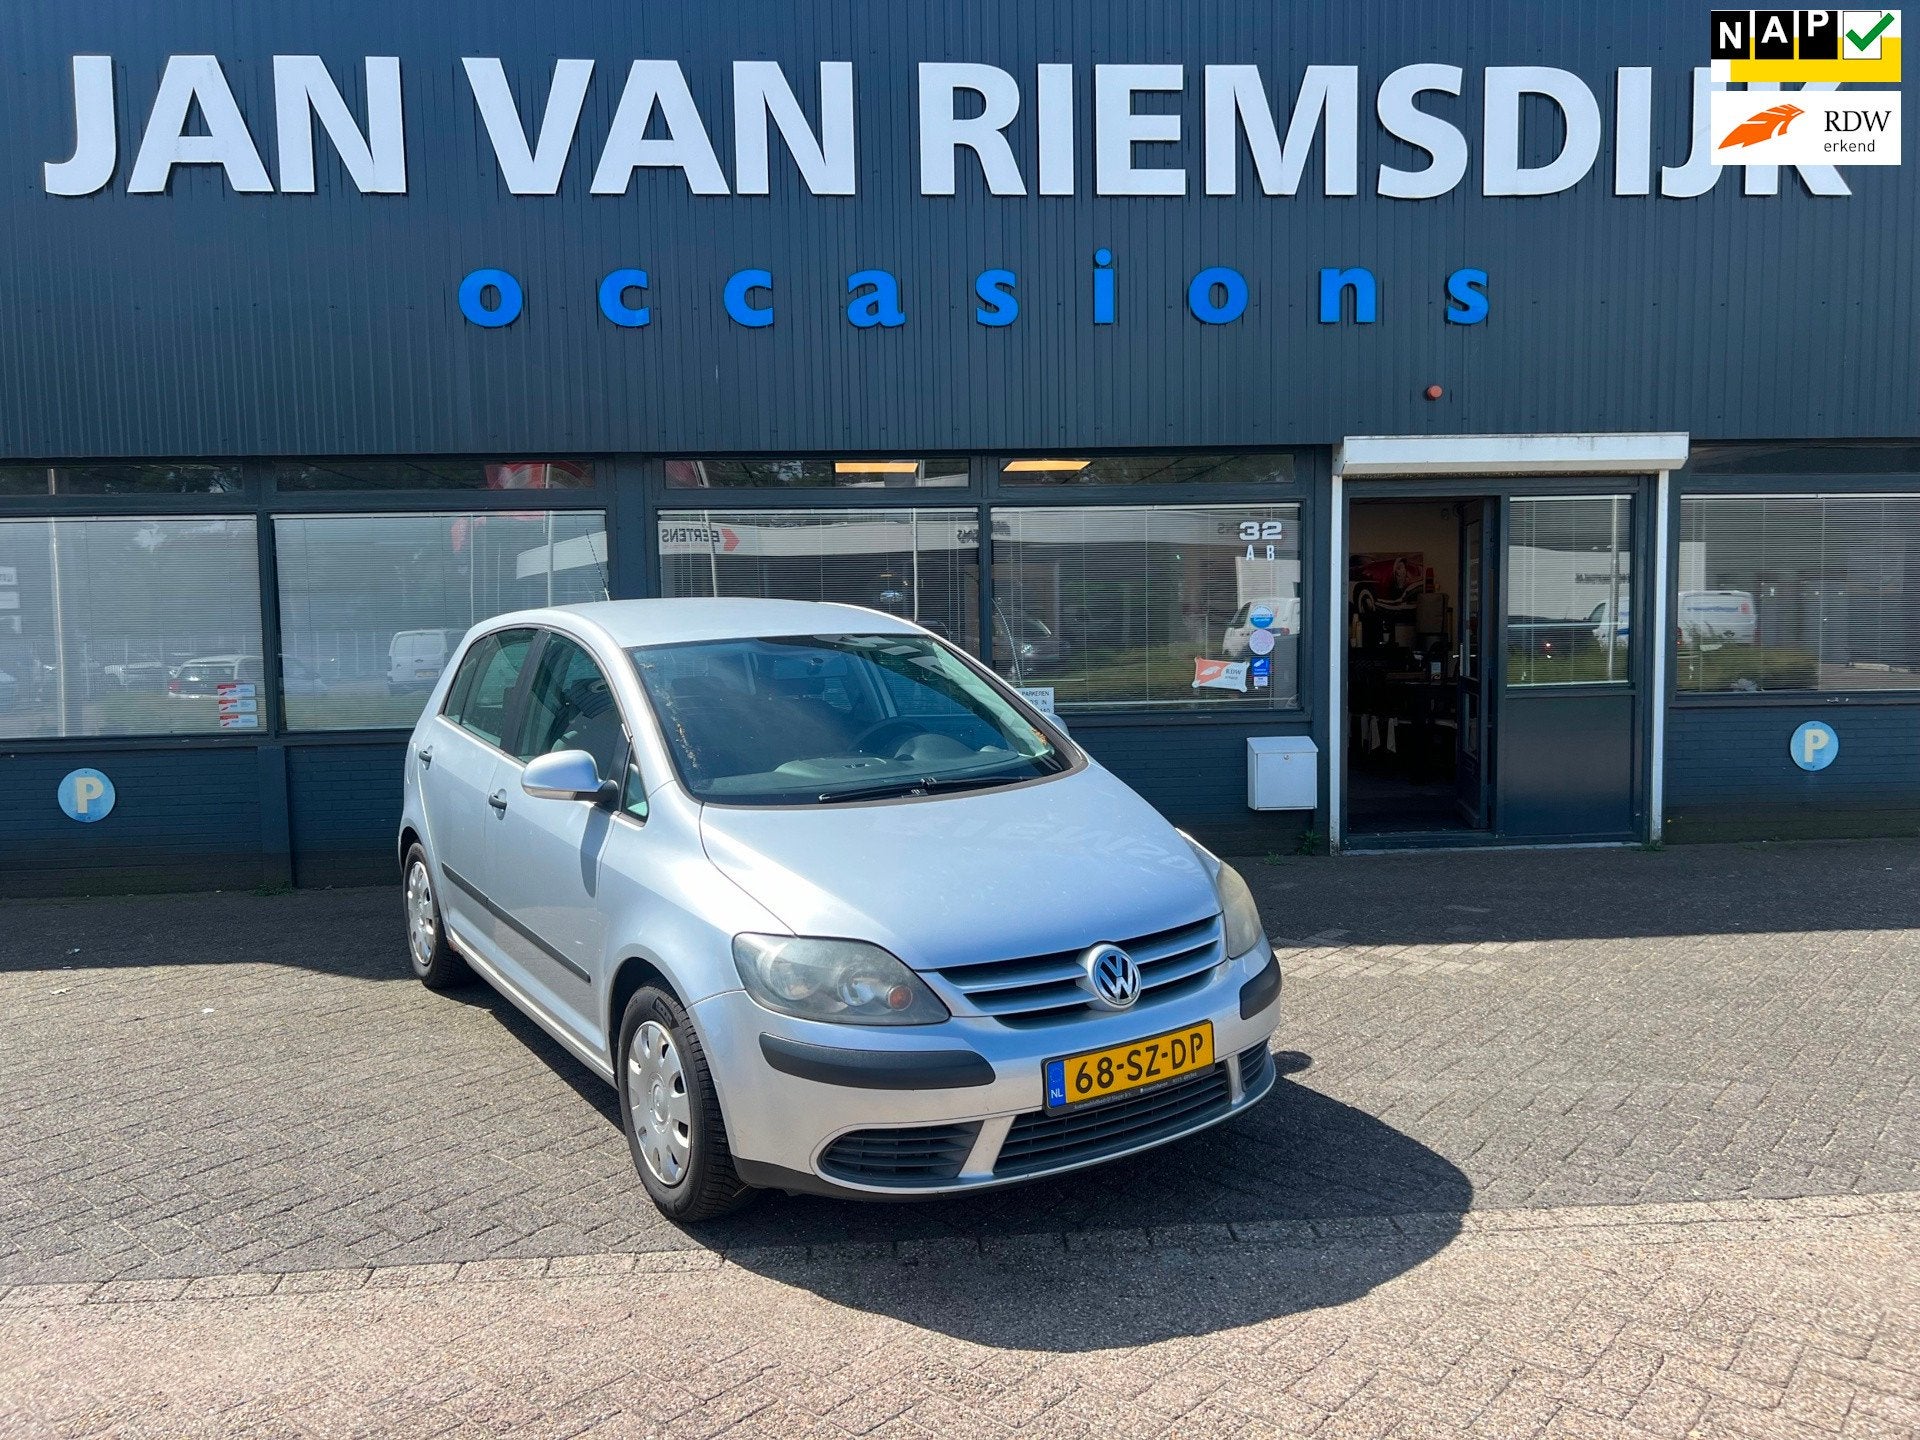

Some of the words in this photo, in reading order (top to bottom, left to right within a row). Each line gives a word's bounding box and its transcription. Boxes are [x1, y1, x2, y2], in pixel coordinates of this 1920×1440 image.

[44, 54, 407, 196] JAN
[461, 57, 856, 195] VAN
[458, 248, 1490, 328] occasions
[1240, 521, 1282, 540] 32
[1245, 544, 1255, 561] A
[1266, 544, 1275, 561] B
[1804, 728, 1830, 763] P
[75, 776, 104, 814] P
[1075, 1032, 1204, 1094] 68-SZ-DP
[1050, 1089, 1064, 1099] NL
